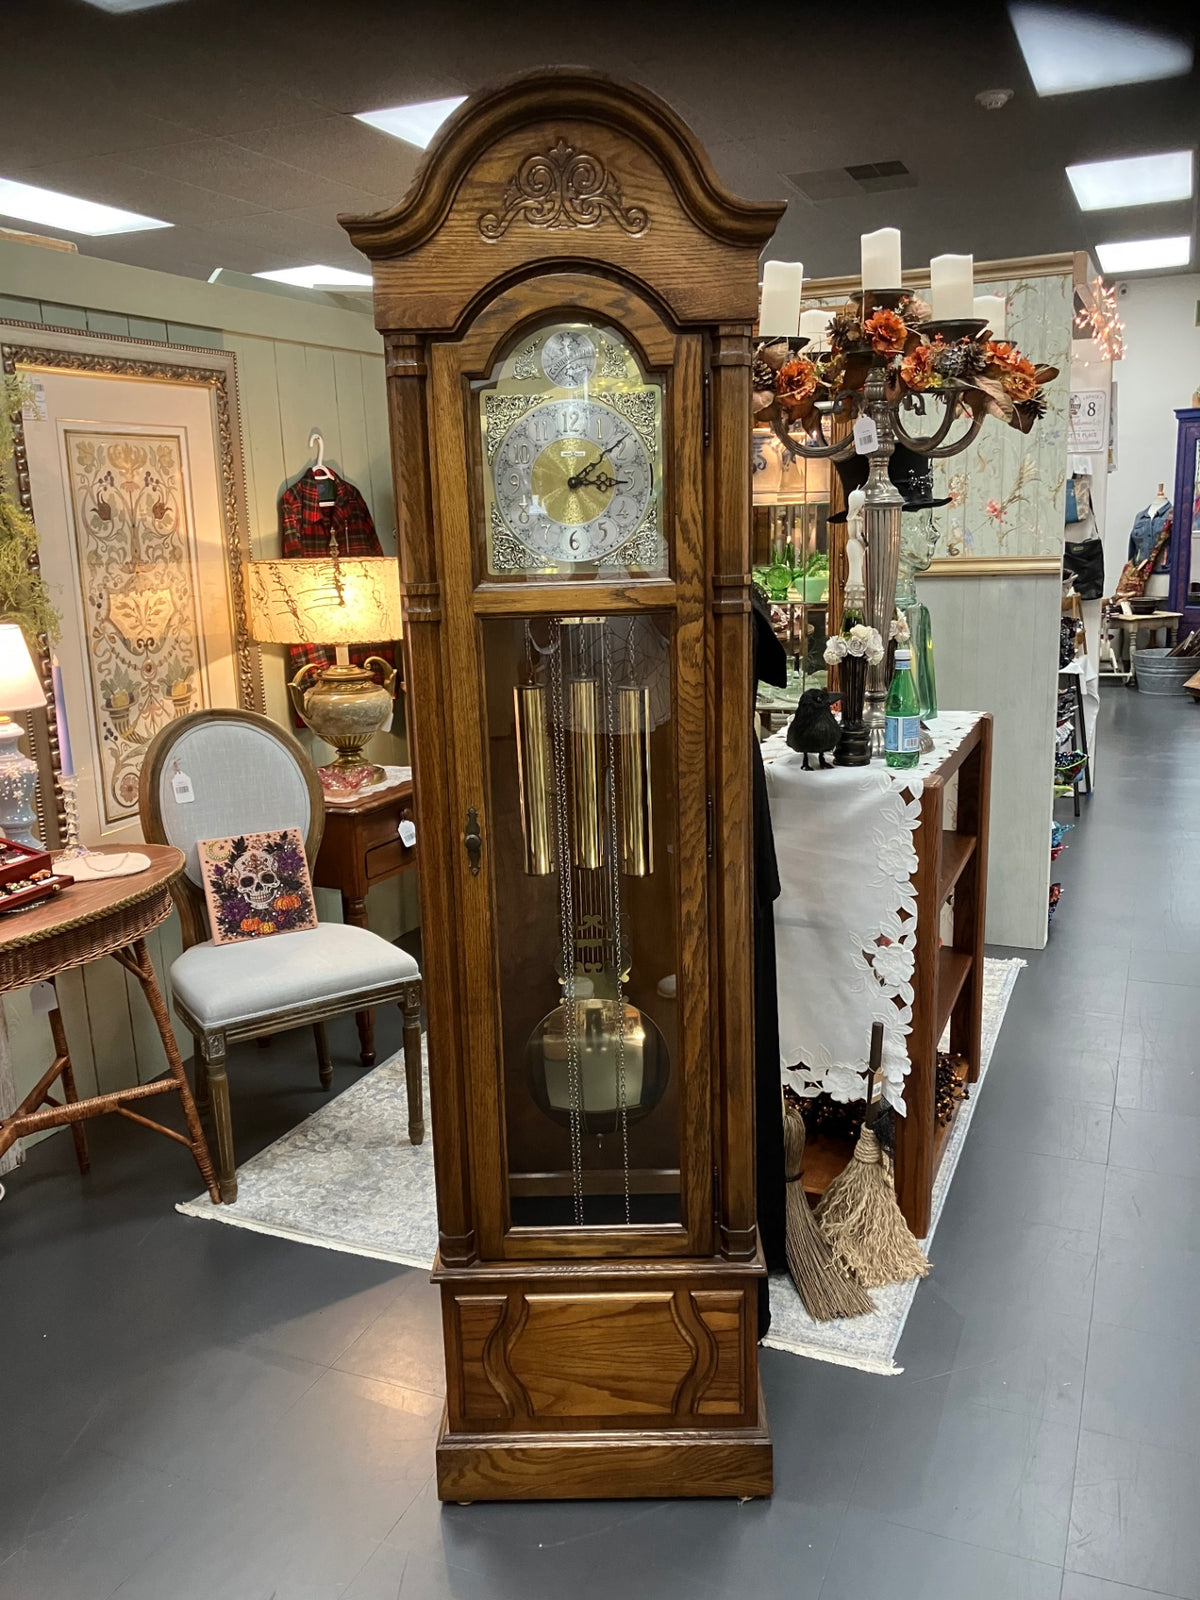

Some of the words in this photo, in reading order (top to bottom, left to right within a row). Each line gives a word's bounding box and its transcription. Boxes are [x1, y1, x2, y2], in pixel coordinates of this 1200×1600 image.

[1087, 401, 1096, 417] 8
[534, 420, 549, 441] 11
[562, 410, 579, 433] 12
[597, 418, 602, 439] 1
[514, 444, 530, 465] 10
[616, 441, 628, 461] 2
[509, 473, 521, 494] 9
[624, 470, 635, 491] 3
[518, 501, 530, 524] 8
[616, 500, 629, 519] 4
[541, 524, 551, 544] 7
[569, 530, 580, 551] 6
[597, 522, 608, 542] 5
